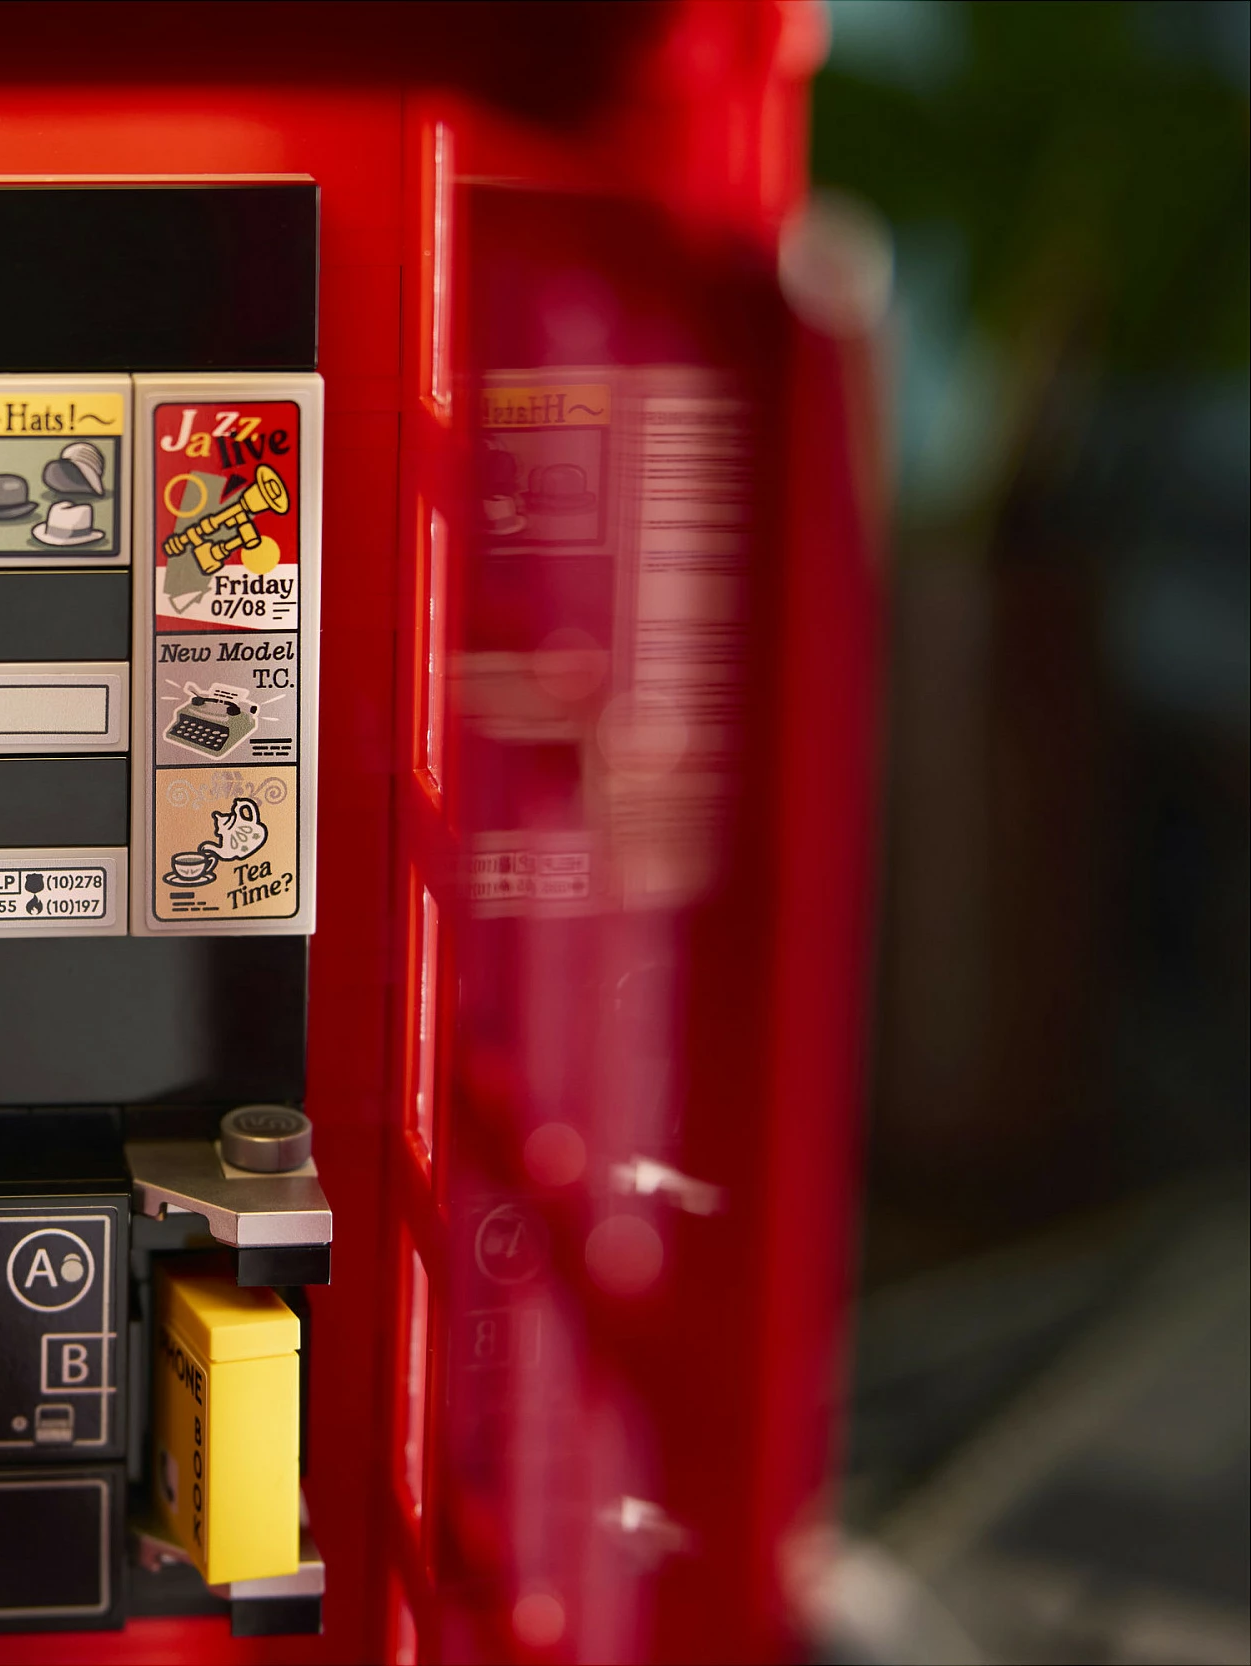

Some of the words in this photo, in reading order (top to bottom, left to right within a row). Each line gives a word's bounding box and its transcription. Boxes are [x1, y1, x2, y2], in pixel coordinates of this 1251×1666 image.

[5, 403, 75, 432] Hats!
[160, 408, 263, 458] Jazz
[216, 429, 291, 470] live
[214, 573, 295, 600] Friday
[210, 597, 267, 619] 07/08
[158, 643, 212, 664] New
[216, 640, 296, 662] Model
[252, 667, 295, 689] T.C.
[46, 874, 103, 891] (10)278
[233, 860, 273, 887] Tea
[226, 872, 294, 911] Time?
[46, 899, 101, 915] (10)197
[24, 1247, 59, 1289] A
[61, 1343, 90, 1384] B
[192, 1415, 203, 1548] BOOK
